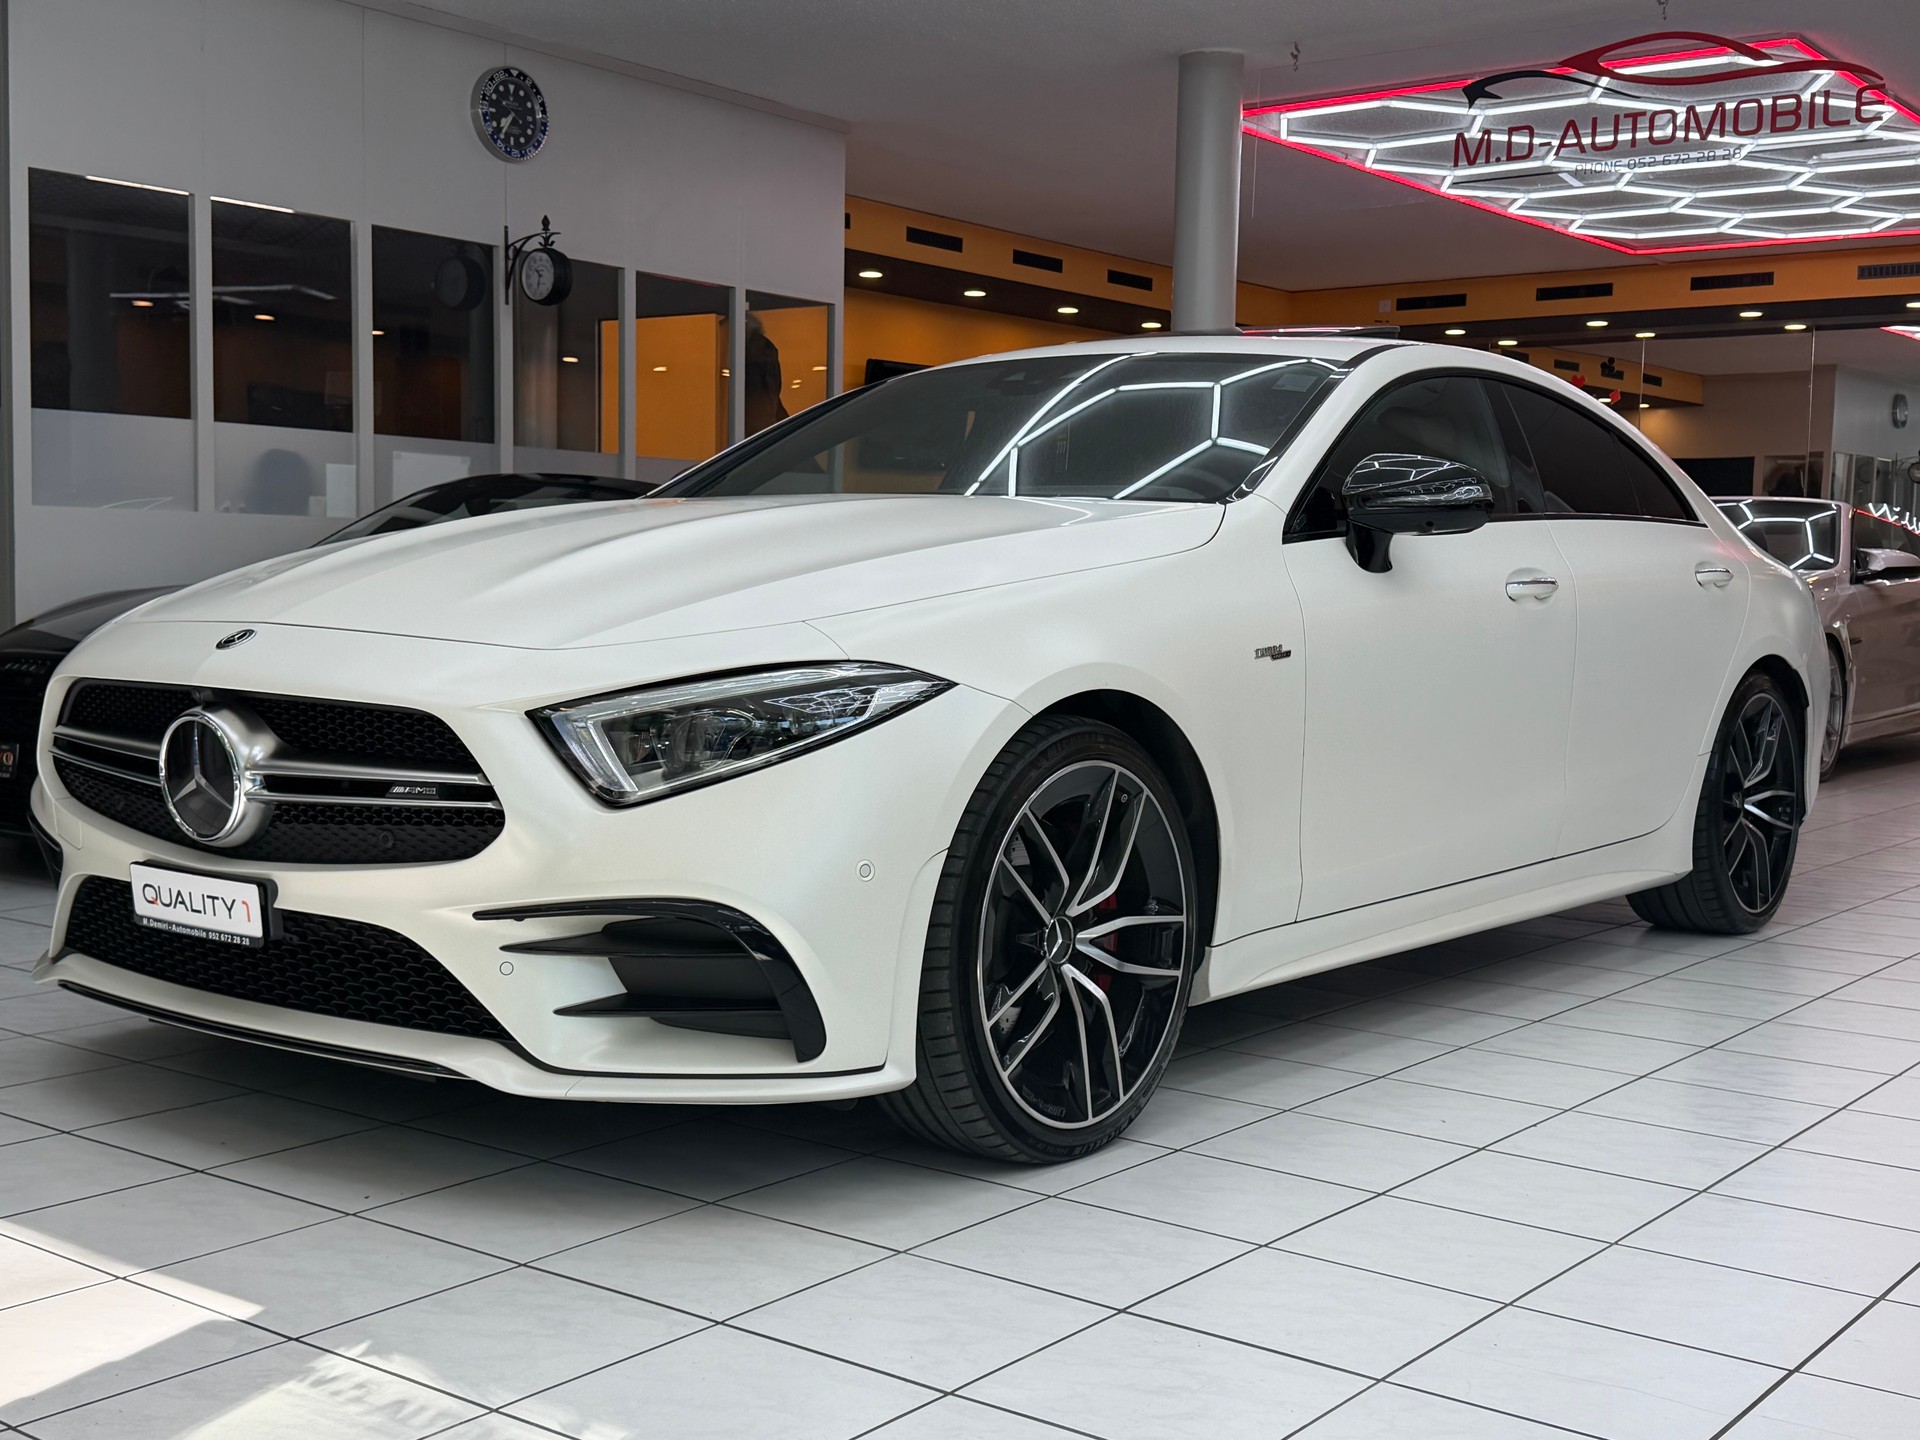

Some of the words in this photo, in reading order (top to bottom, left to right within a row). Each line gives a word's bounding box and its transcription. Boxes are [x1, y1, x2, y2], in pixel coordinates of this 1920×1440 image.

[1453, 83, 1886, 167] M.D-AUTOMOBILE
[1575, 160, 1623, 175] PHONE
[1627, 157, 1656, 170] 052
[1662, 153, 1690, 166] 672
[1697, 150, 1716, 163] 28
[1722, 148, 1742, 161] 28
[142, 883, 236, 920] QUALITY
[209, 932, 219, 941] 052
[220, 934, 231, 943] 672
[233, 936, 241, 945] 28
[242, 938, 250, 946] 28
